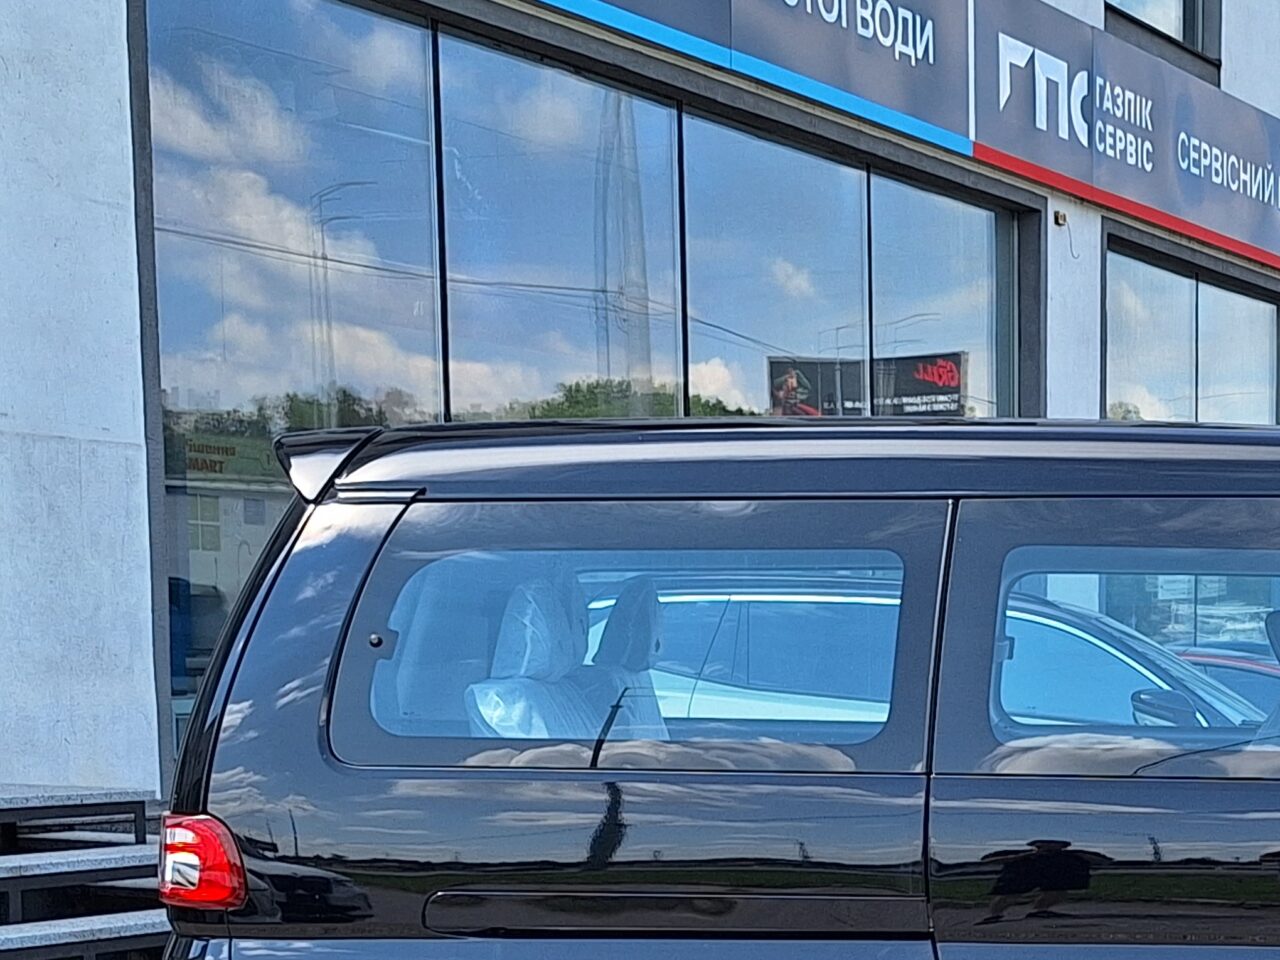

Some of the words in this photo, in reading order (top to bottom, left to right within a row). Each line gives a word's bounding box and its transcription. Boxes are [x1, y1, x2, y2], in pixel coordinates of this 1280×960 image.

[856, 0, 934, 67] ВОДИ
[1095, 75, 1154, 132] ГАЗПІК
[1095, 120, 1154, 173] СЕРВІС
[1177, 131, 1275, 205] СЕРВІСНИЙ
